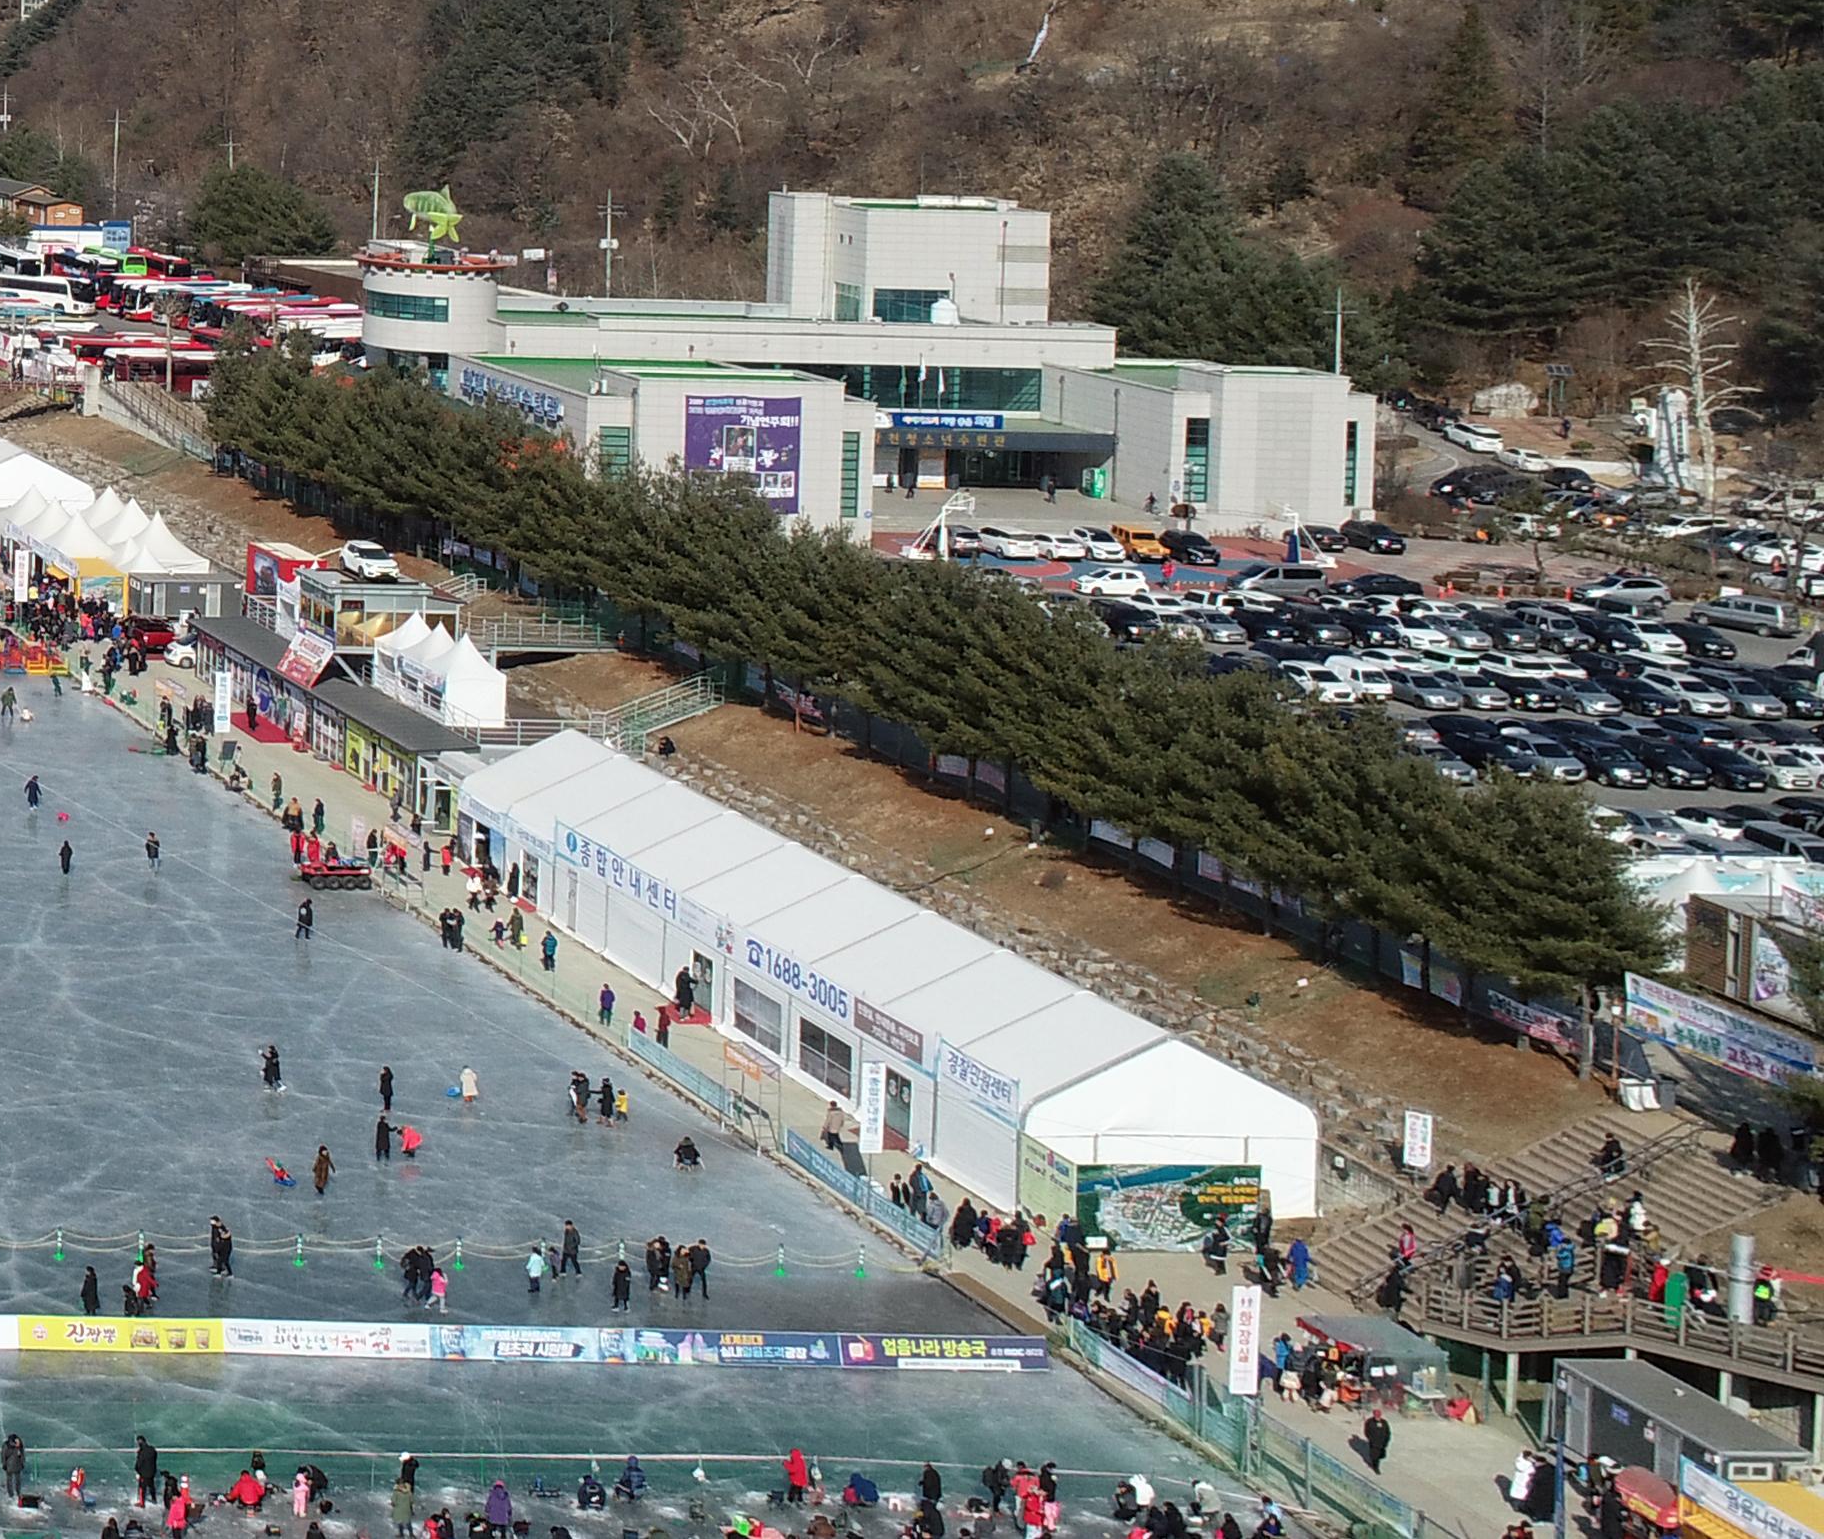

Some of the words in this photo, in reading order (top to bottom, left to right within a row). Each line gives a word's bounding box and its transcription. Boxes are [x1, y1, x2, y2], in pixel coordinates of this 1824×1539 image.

[580, 840, 677, 919] 종합안내센터
[766, 947, 848, 1019] 1688-3005
[66, 1323, 117, 1342] 진짬뽕
[881, 1338, 940, 1357] 얼음나라
[942, 1339, 987, 1357] 방송국
[1238, 1313, 1254, 1363] 화장실
[1724, 1488, 1785, 1534] 얼음나라
